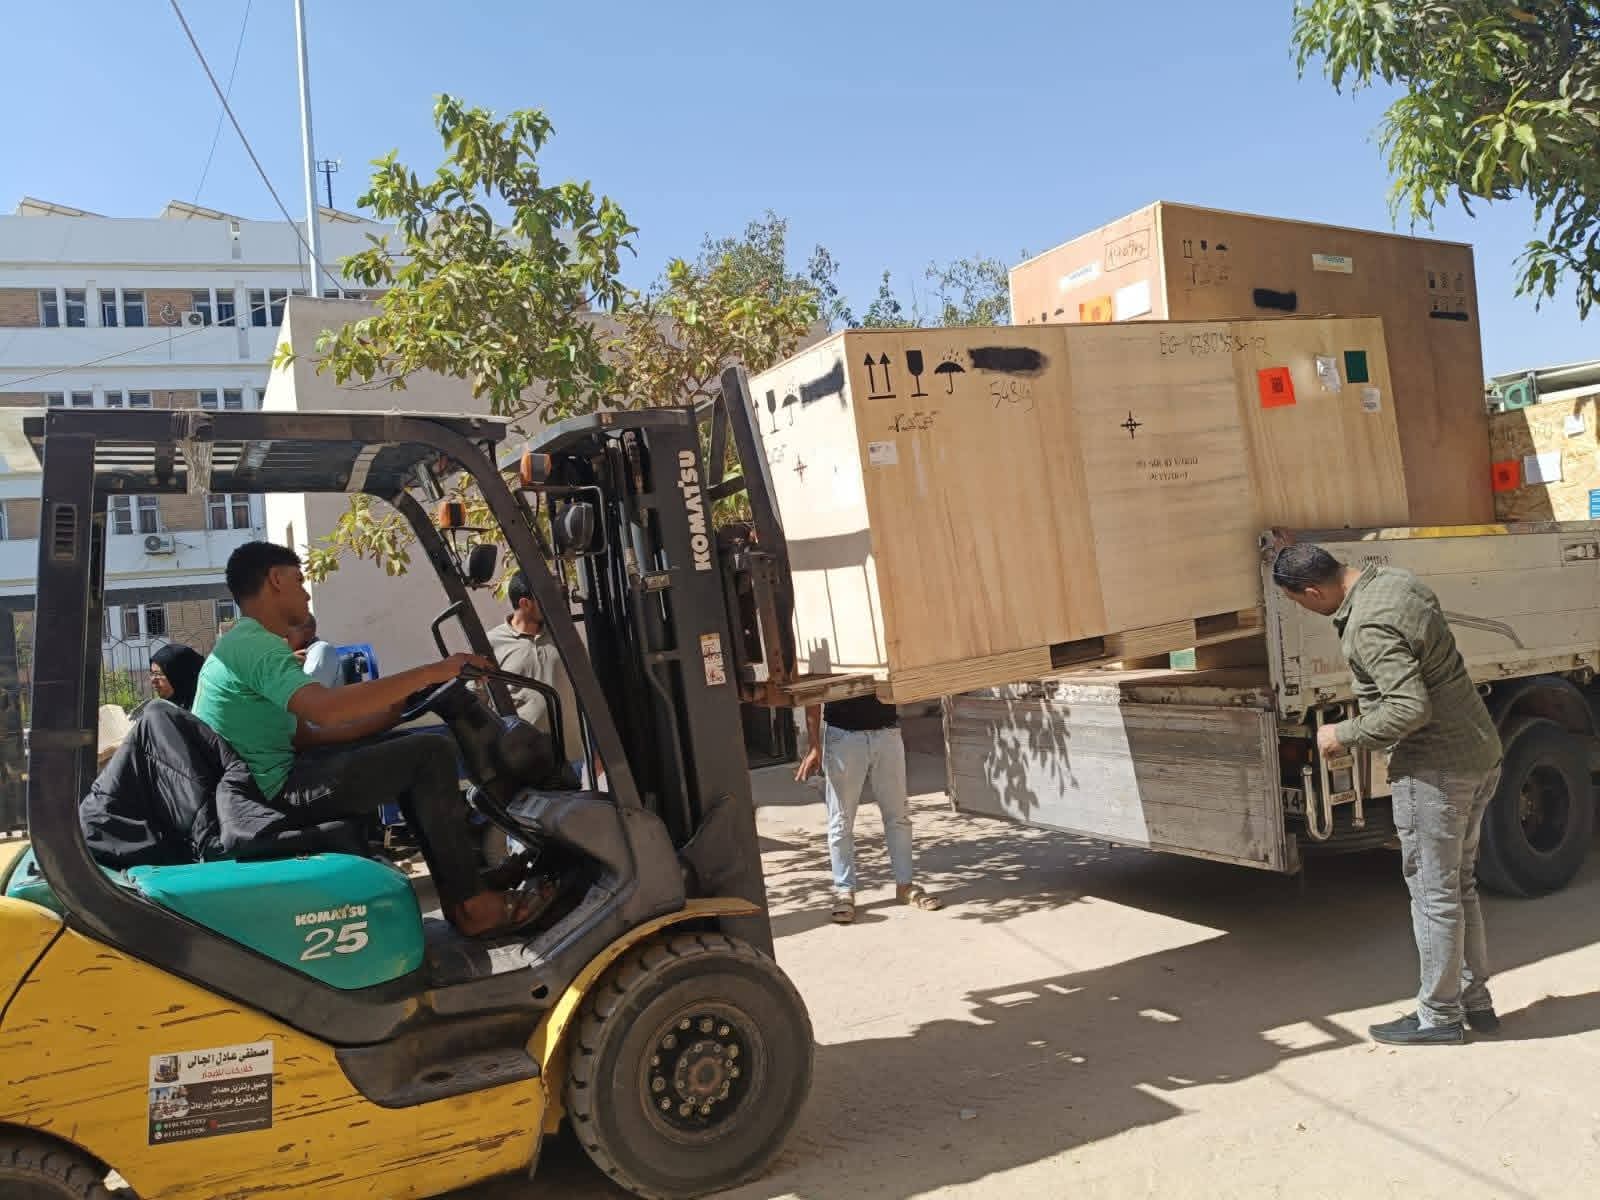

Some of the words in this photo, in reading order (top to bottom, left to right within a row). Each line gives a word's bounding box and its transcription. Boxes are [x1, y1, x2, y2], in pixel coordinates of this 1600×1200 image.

[678, 450, 712, 571] KOMATSU
[295, 904, 367, 926] KOMATSU
[300, 920, 369, 961] 25
